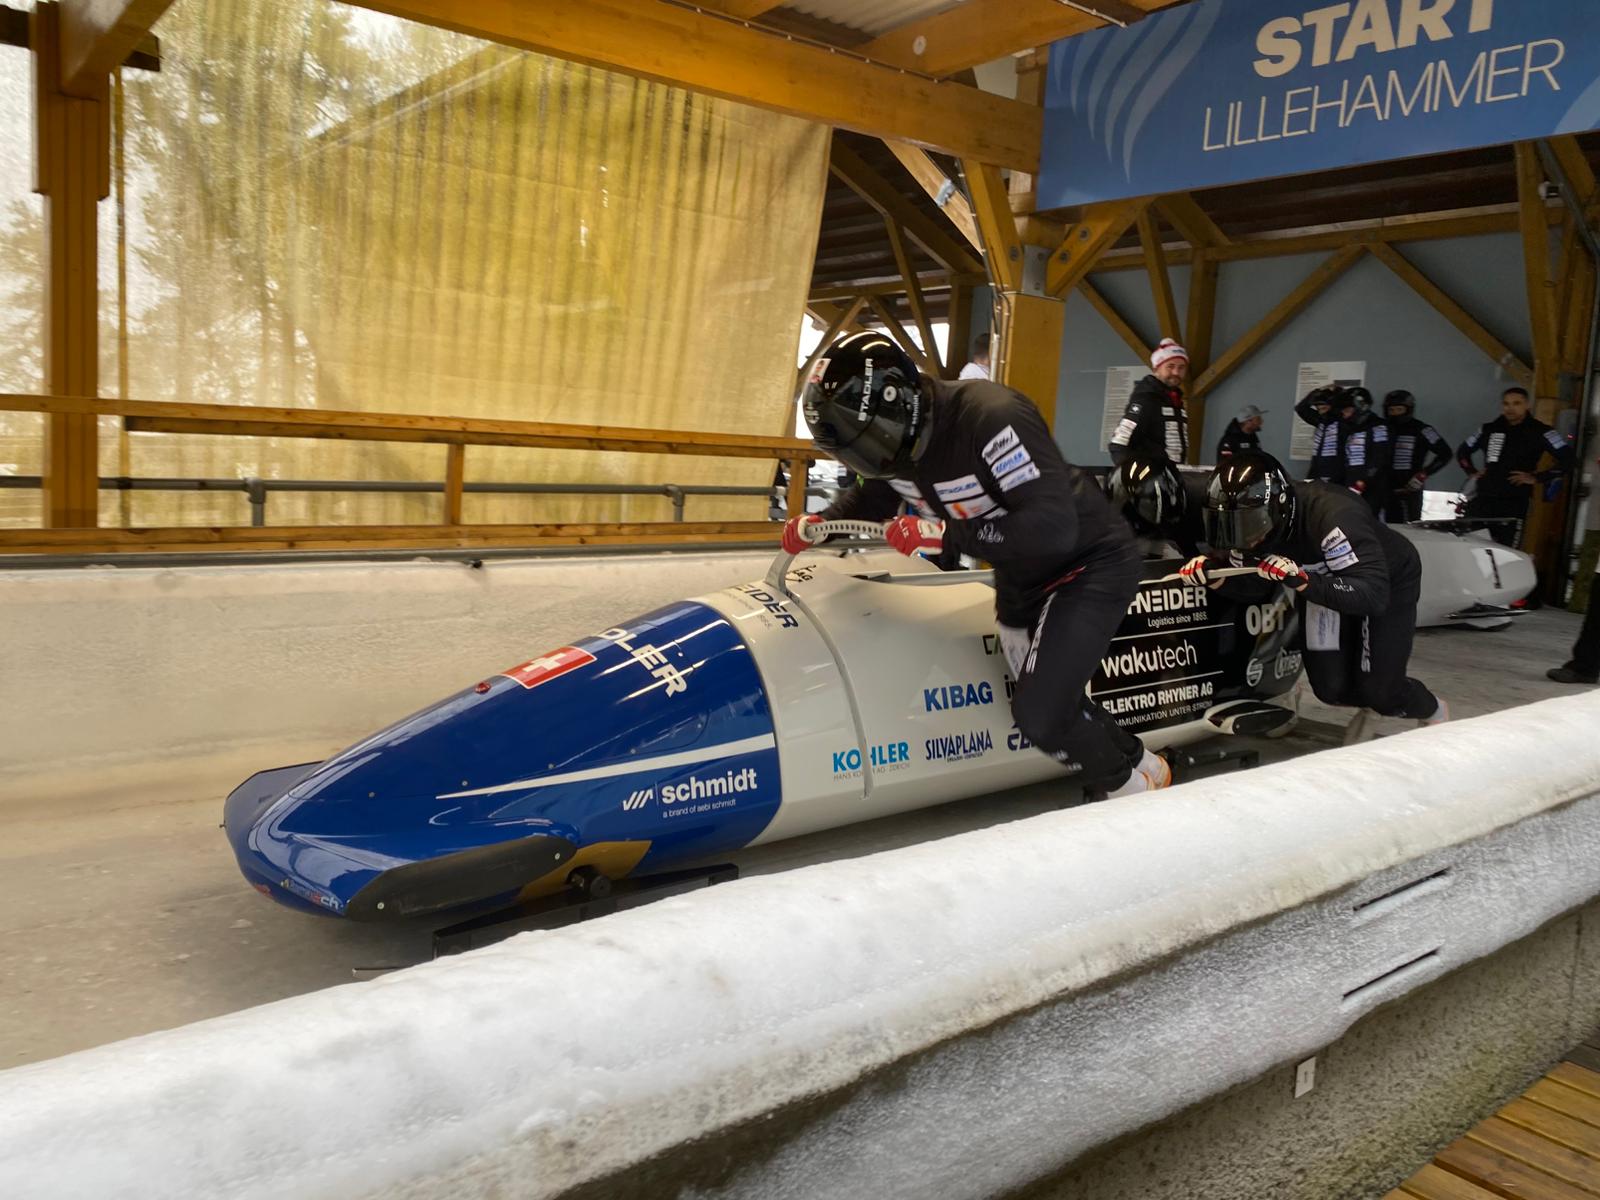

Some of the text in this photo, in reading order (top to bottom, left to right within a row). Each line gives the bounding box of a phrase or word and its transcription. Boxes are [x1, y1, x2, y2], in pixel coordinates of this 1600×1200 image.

[1253, 0, 1497, 78] START
[1202, 38, 1565, 152] LILLEHAMMER
[857, 358, 874, 422] STADLER
[1147, 615, 1175, 629] Logistics
[1175, 614, 1192, 624] since
[1101, 639, 1199, 679] wakutech
[923, 681, 994, 712] KIBAG
[1103, 682, 1214, 714] ELEKTRO RHYNER AG
[1169, 704, 1192, 717] UNTER
[925, 728, 994, 762] SILVAPLANA
[661, 768, 758, 804] schmidt
[662, 810, 668, 818] a
[669, 806, 689, 817] brand
[689, 804, 697, 814] of
[711, 798, 737, 810] schmidt
